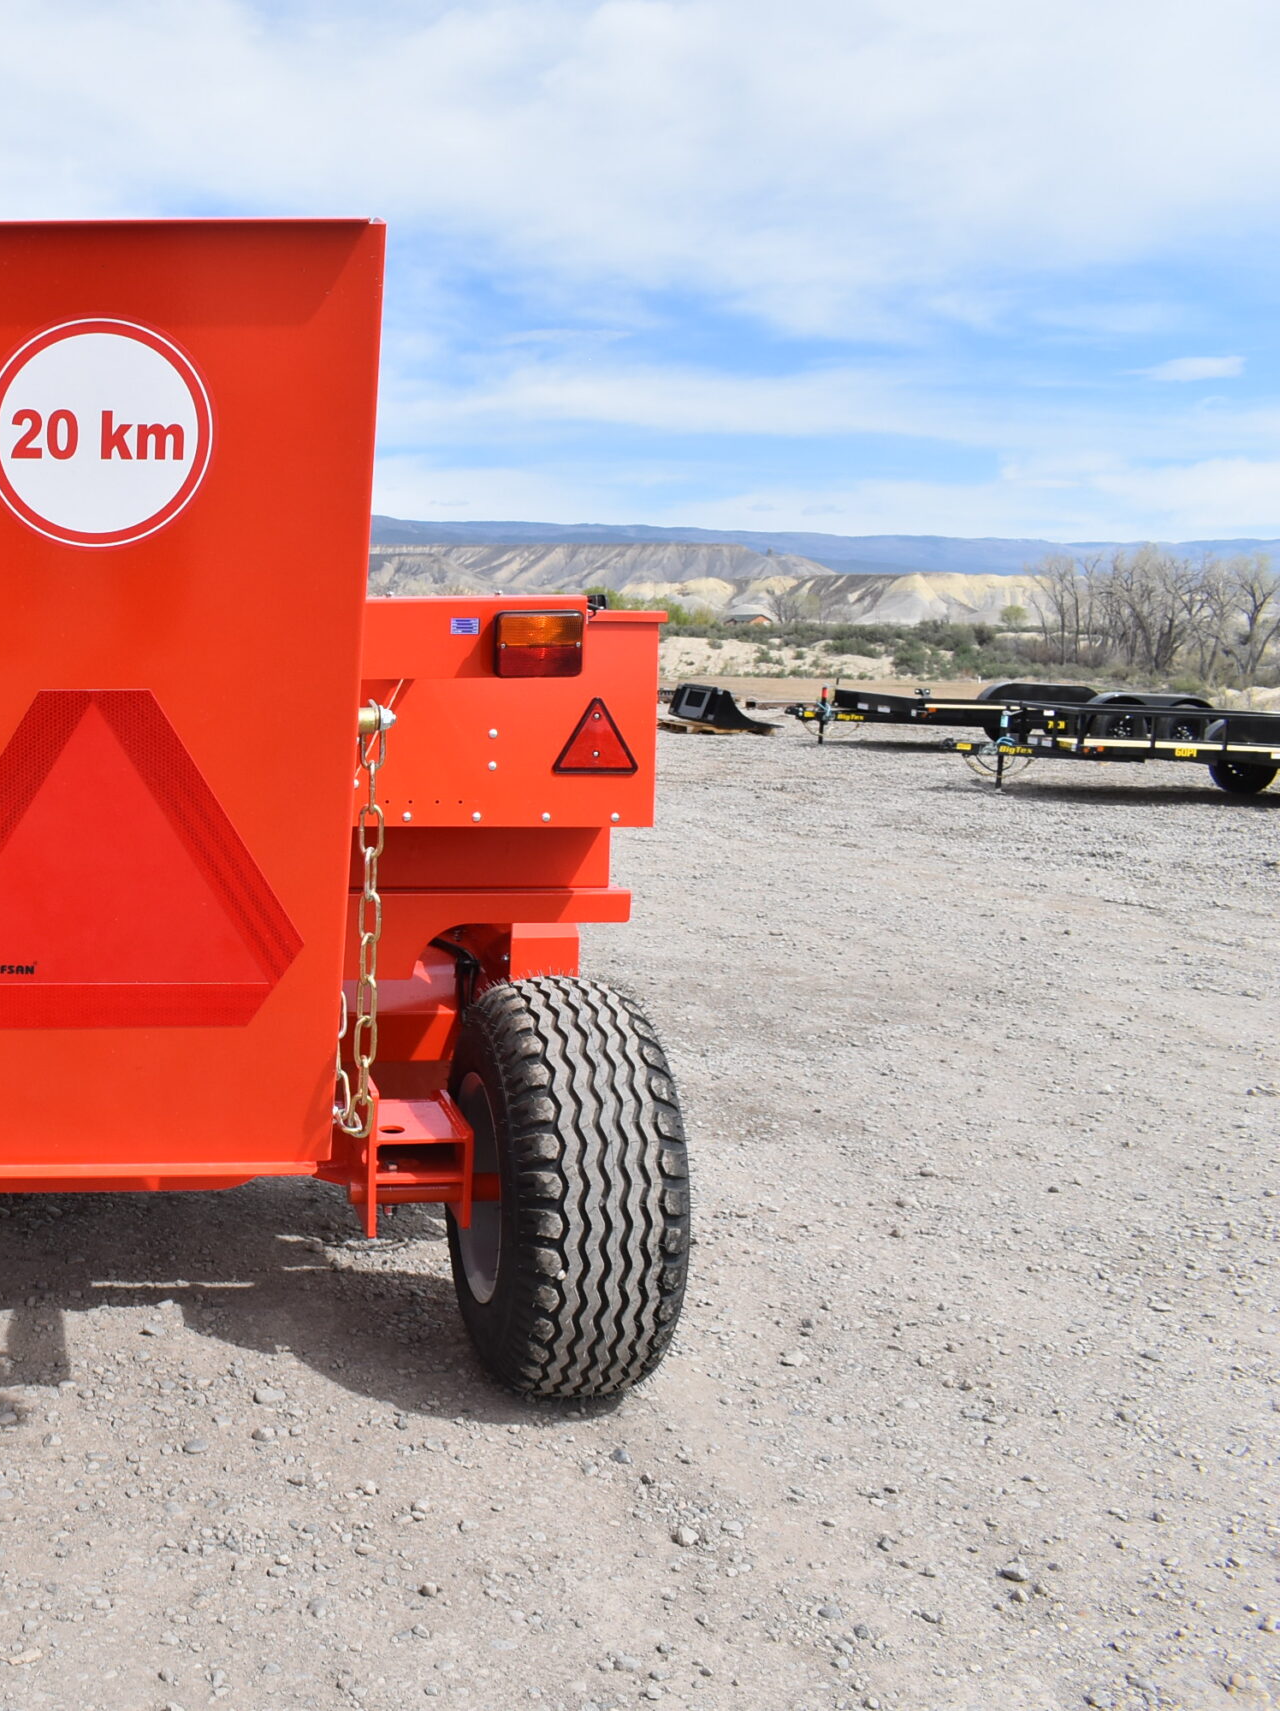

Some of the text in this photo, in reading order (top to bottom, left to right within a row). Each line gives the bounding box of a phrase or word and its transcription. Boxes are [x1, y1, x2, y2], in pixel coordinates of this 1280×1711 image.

[11, 409, 185, 460] 20 km
[999, 745, 1033, 755] BigTex
